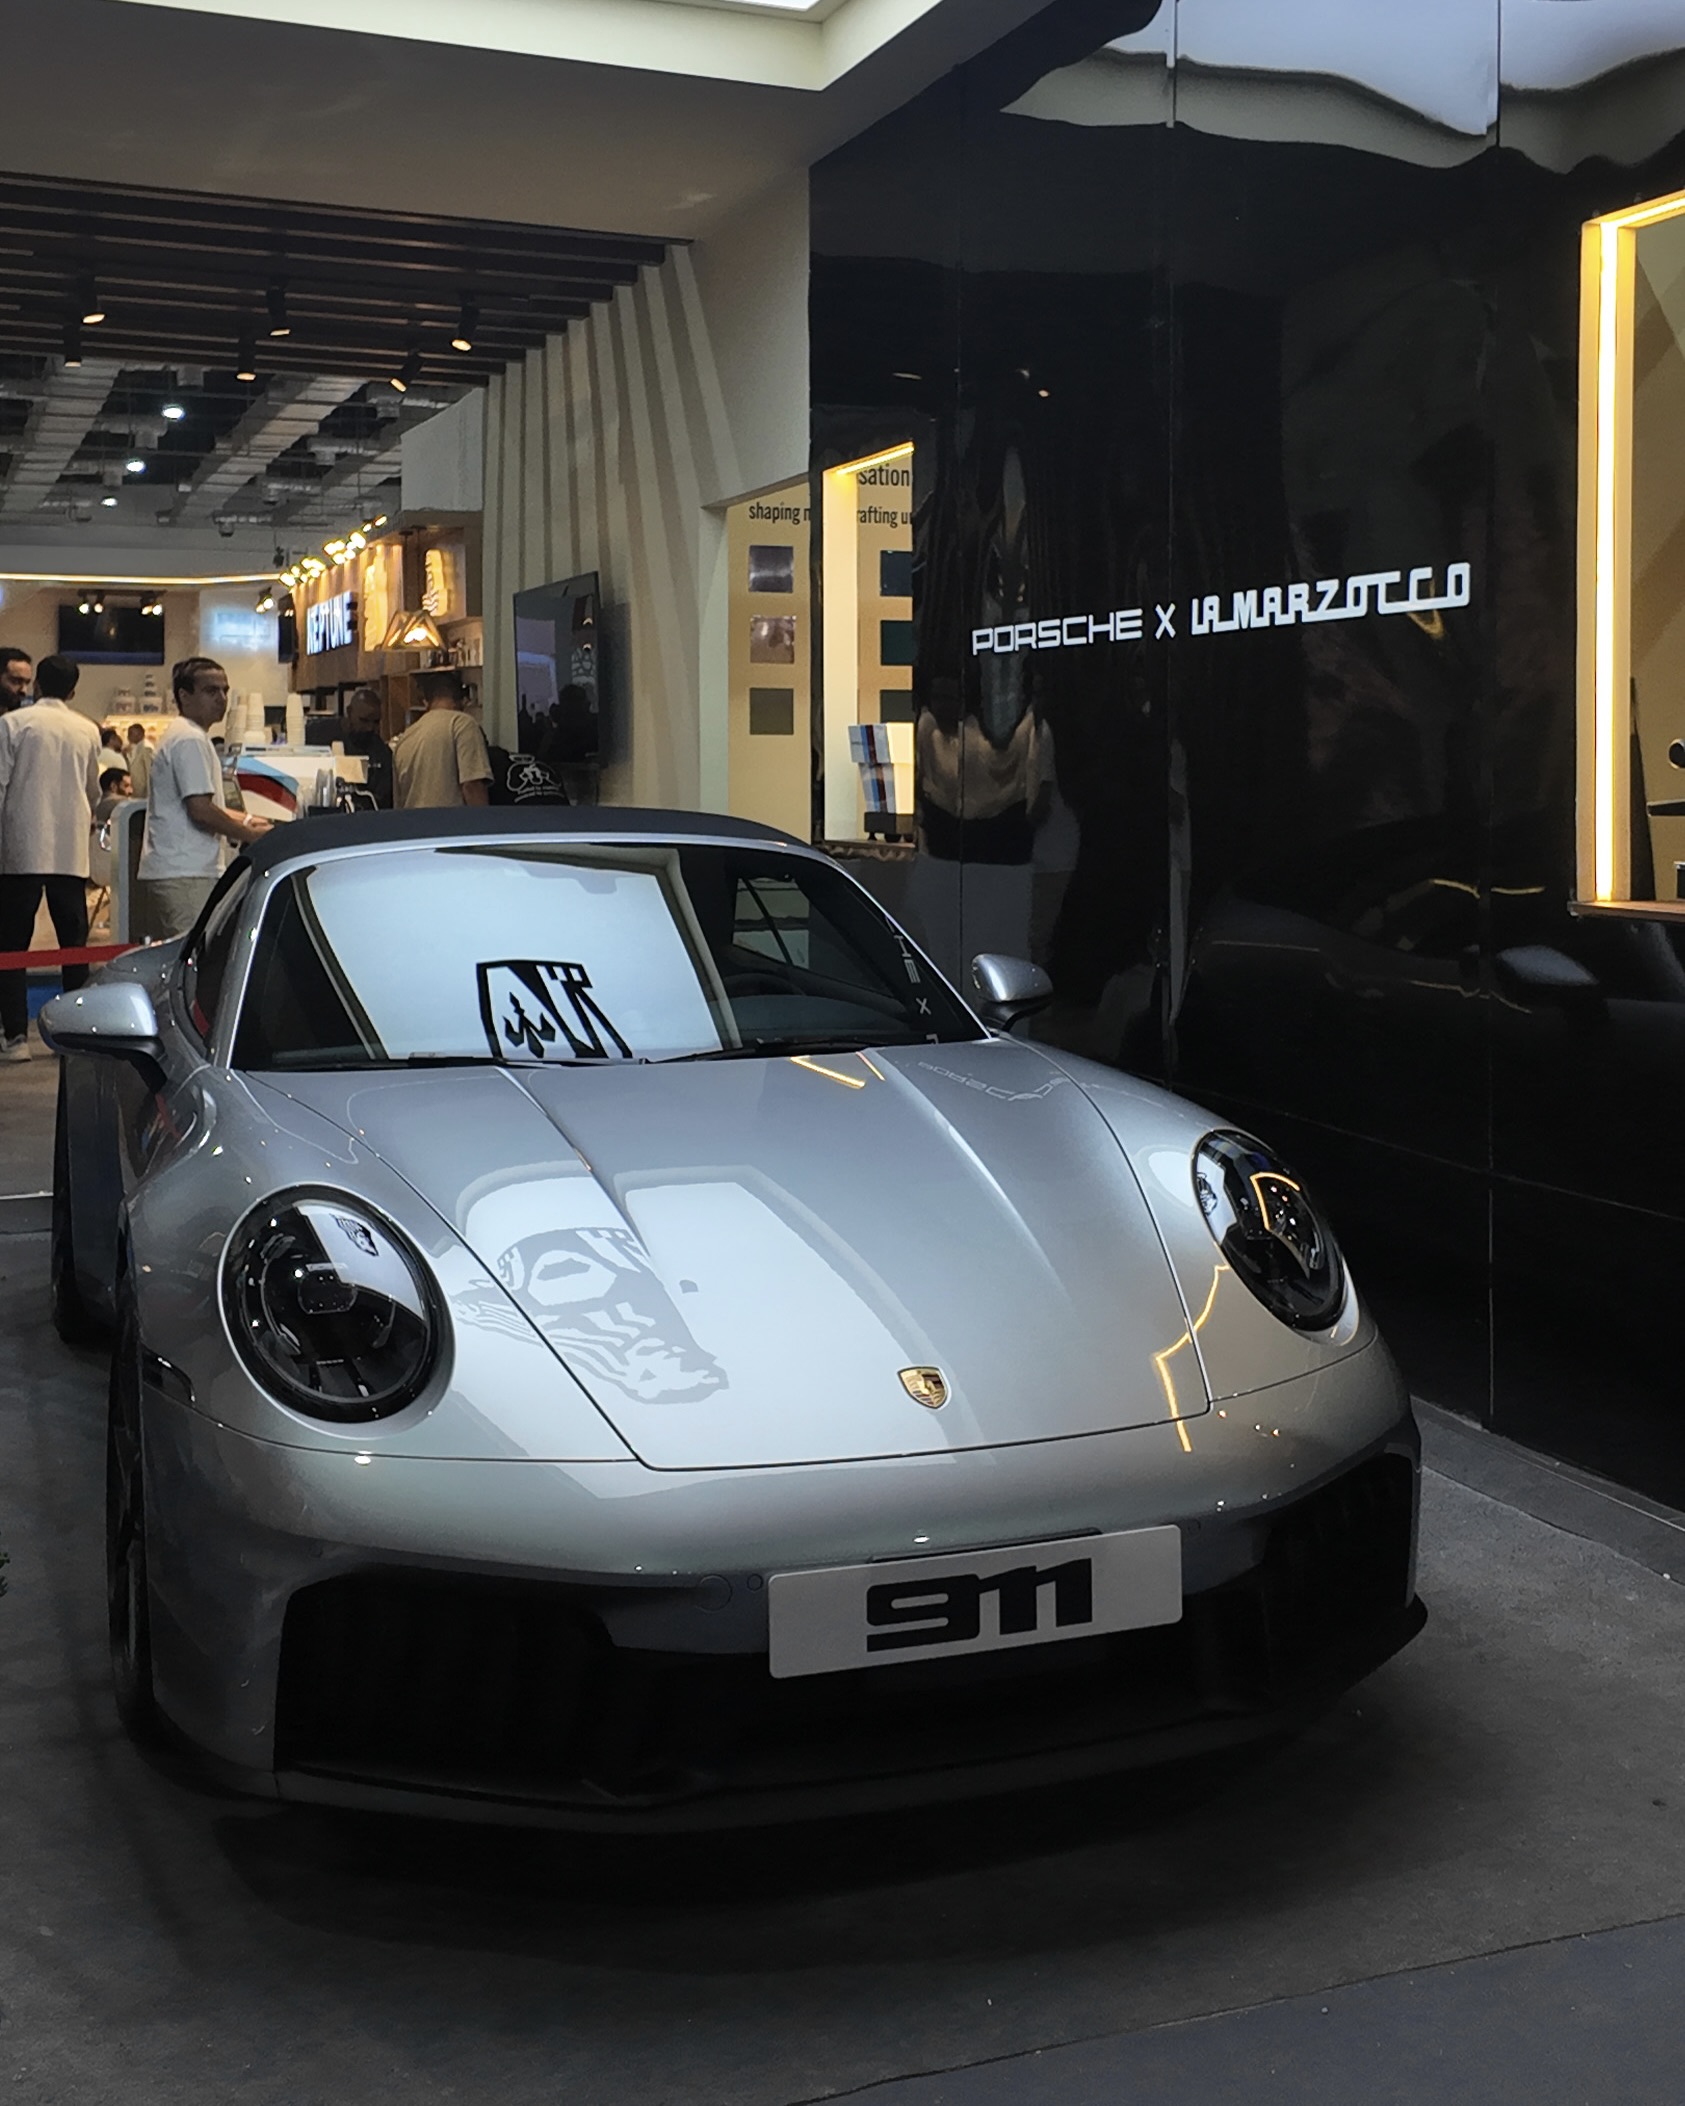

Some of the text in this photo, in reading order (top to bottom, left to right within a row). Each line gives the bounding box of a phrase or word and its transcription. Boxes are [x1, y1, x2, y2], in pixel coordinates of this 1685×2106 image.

[749, 501, 801, 525] shaping
[972, 608, 1143, 656] PORSCHE
[1155, 603, 1176, 640] X
[866, 1557, 1093, 1653] 911
